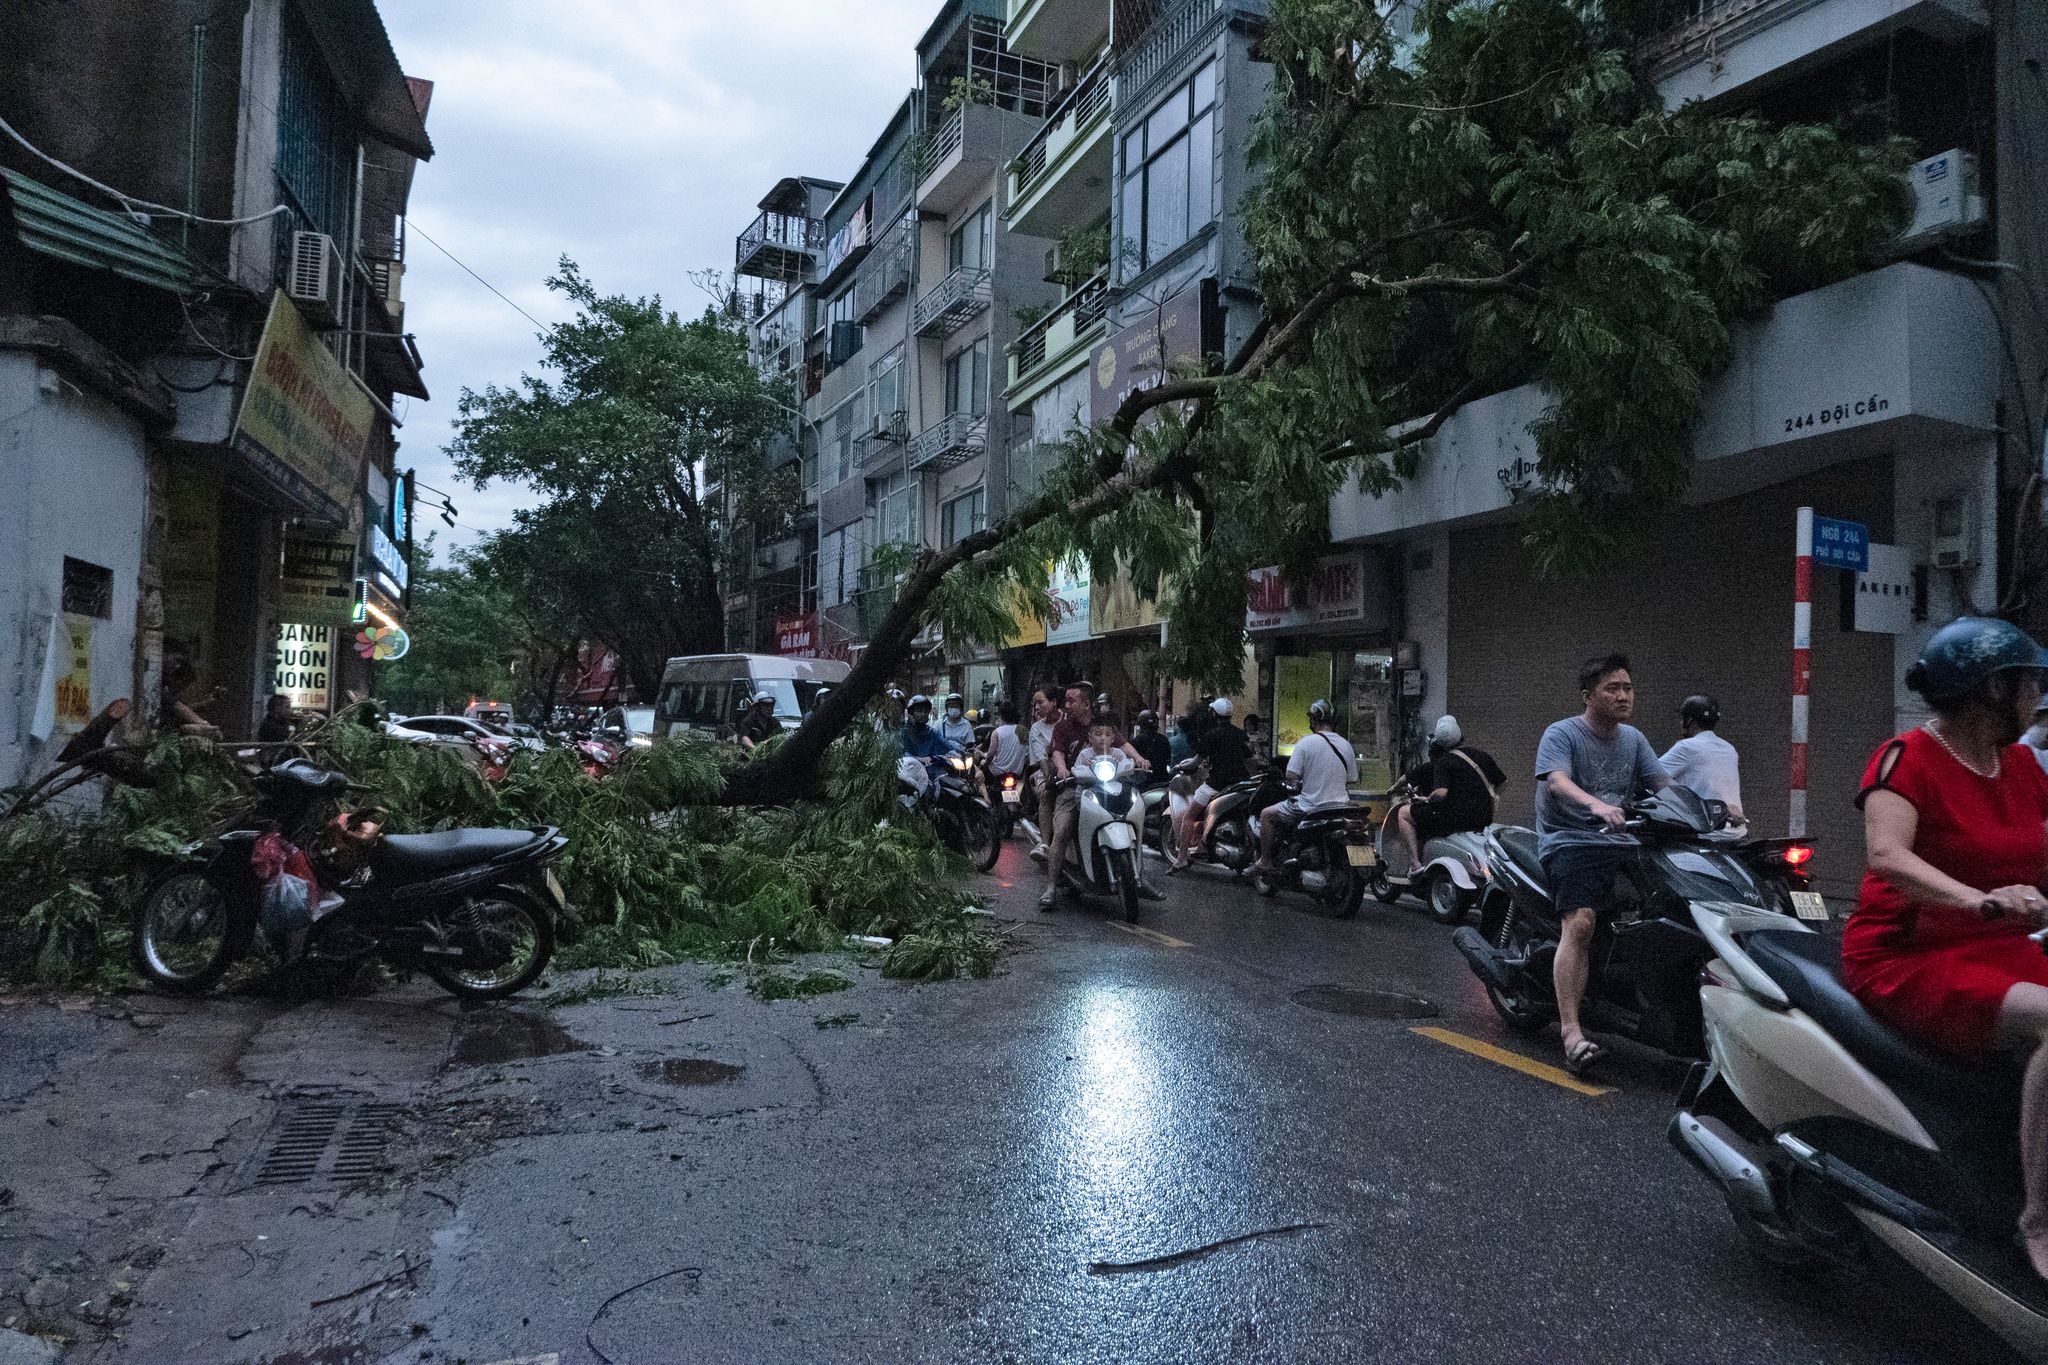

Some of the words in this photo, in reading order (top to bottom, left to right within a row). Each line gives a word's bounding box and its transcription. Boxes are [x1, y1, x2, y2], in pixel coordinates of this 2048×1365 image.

[1153, 314, 1178, 337] GANG
[1785, 413, 1814, 431] 244
[1819, 403, 1848, 423] Đội
[1853, 394, 1887, 414] Cấn
